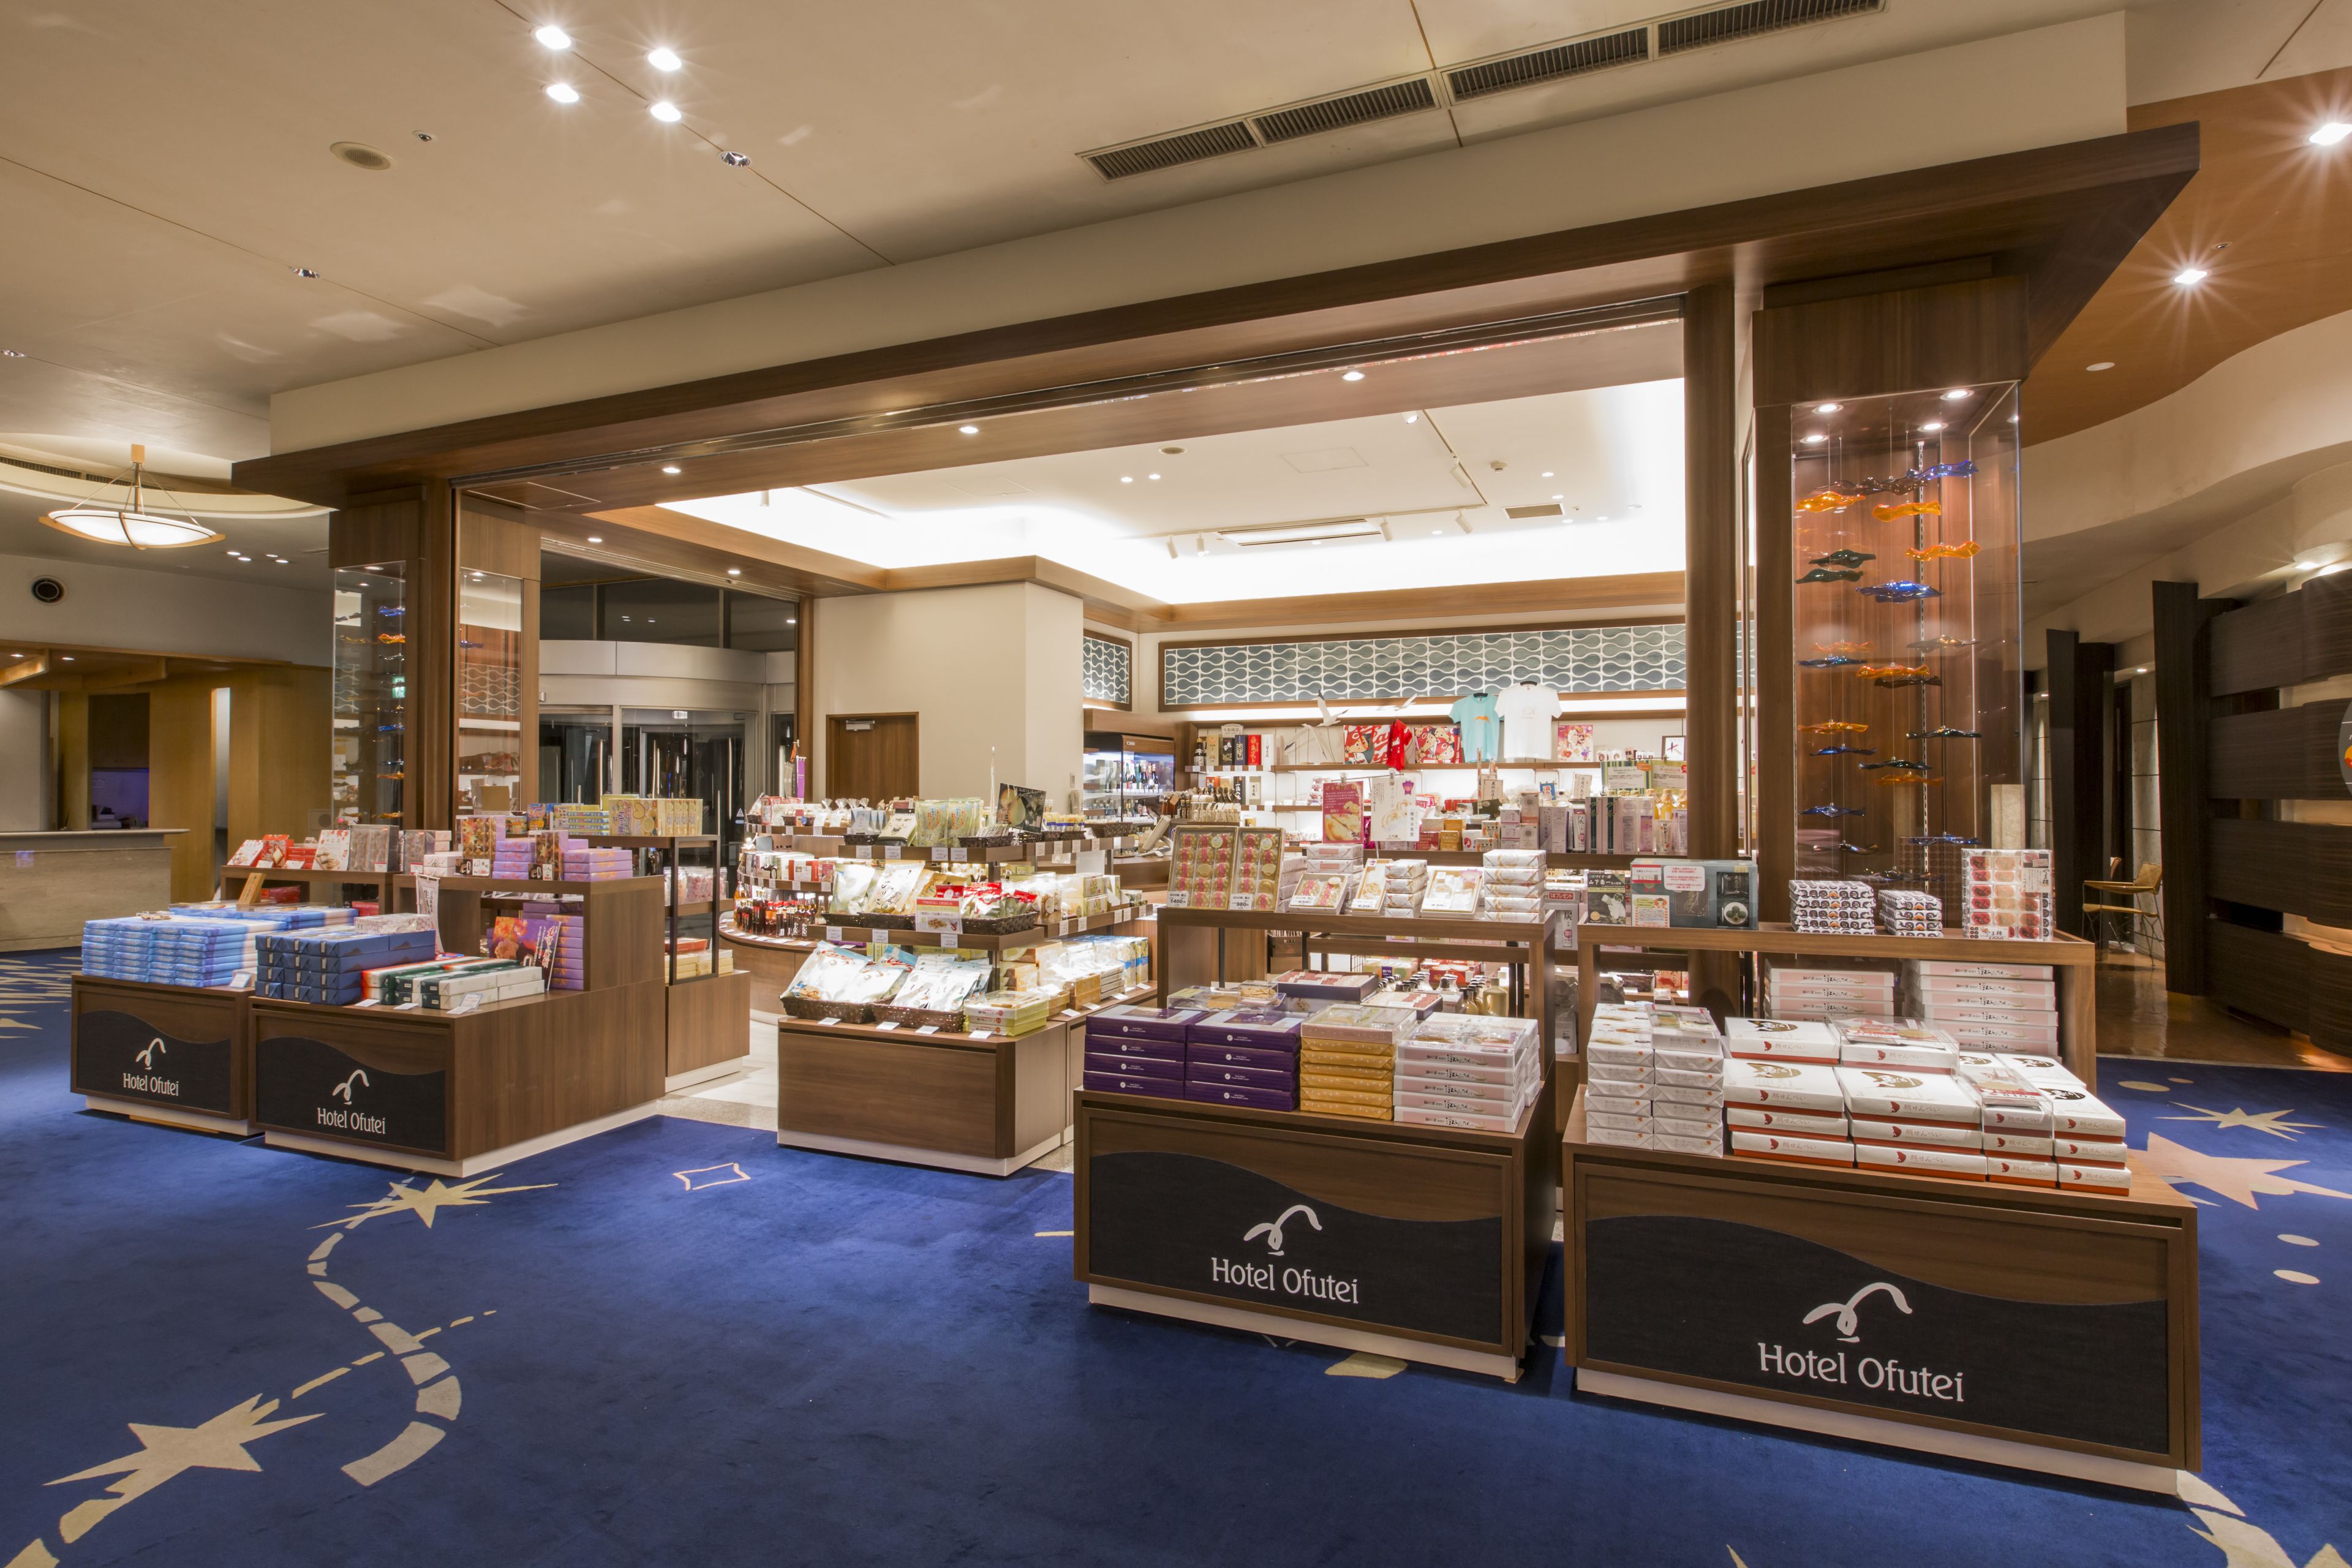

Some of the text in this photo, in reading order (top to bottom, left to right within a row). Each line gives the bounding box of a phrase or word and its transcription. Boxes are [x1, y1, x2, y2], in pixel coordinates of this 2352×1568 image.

[123, 1072, 179, 1096] Hotel Ofutei
[317, 1107, 386, 1135] Hotel Ofutei
[1211, 1257, 1359, 1304] Hotel Ofutei
[1757, 1342, 1965, 1403] Hotel Ofutei
